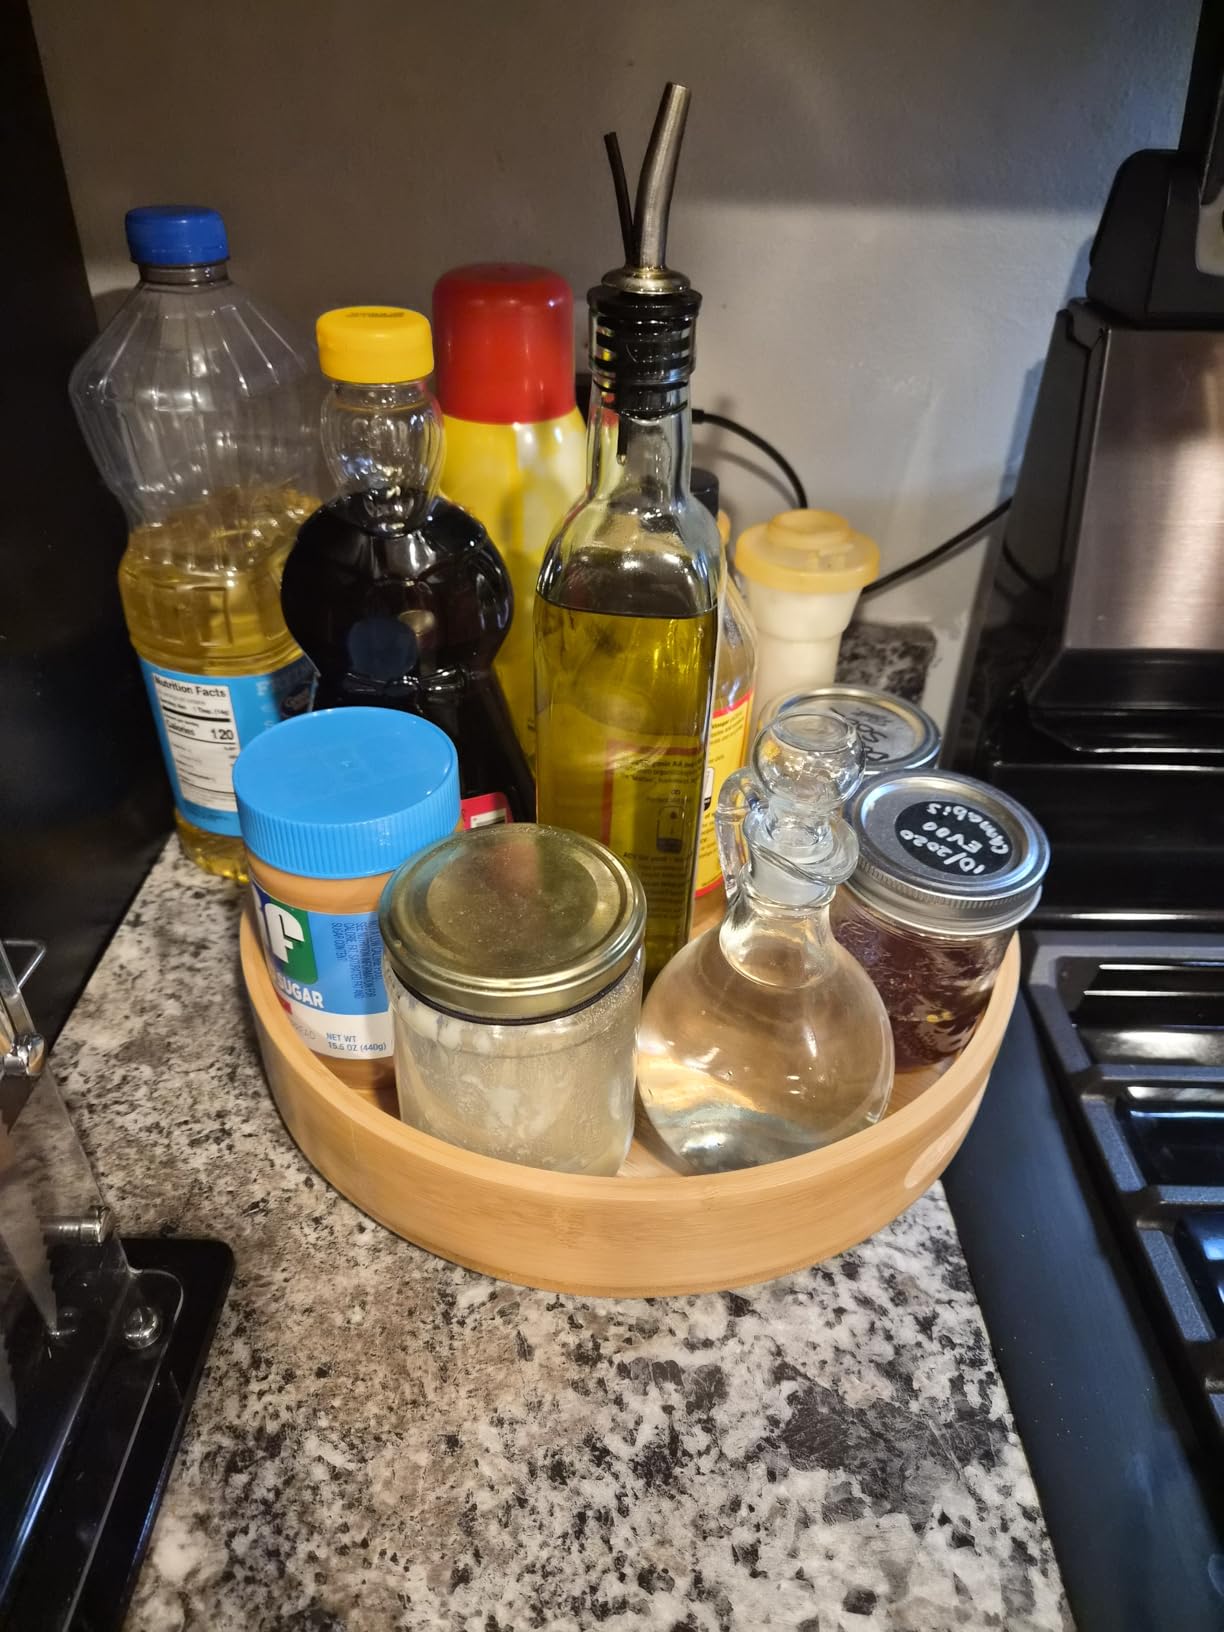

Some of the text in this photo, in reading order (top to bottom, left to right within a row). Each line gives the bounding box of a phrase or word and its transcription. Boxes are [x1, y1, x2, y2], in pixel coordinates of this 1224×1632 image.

[154, 675, 194, 694] Nutrition
[195, 686, 226, 697] Facts
[211, 729, 234, 740] 120
[922, 821, 983, 854] EVOO
[900, 829, 986, 875] 10/2020
[275, 971, 325, 1009] SUGAR
[326, 1032, 341, 1041] NET
